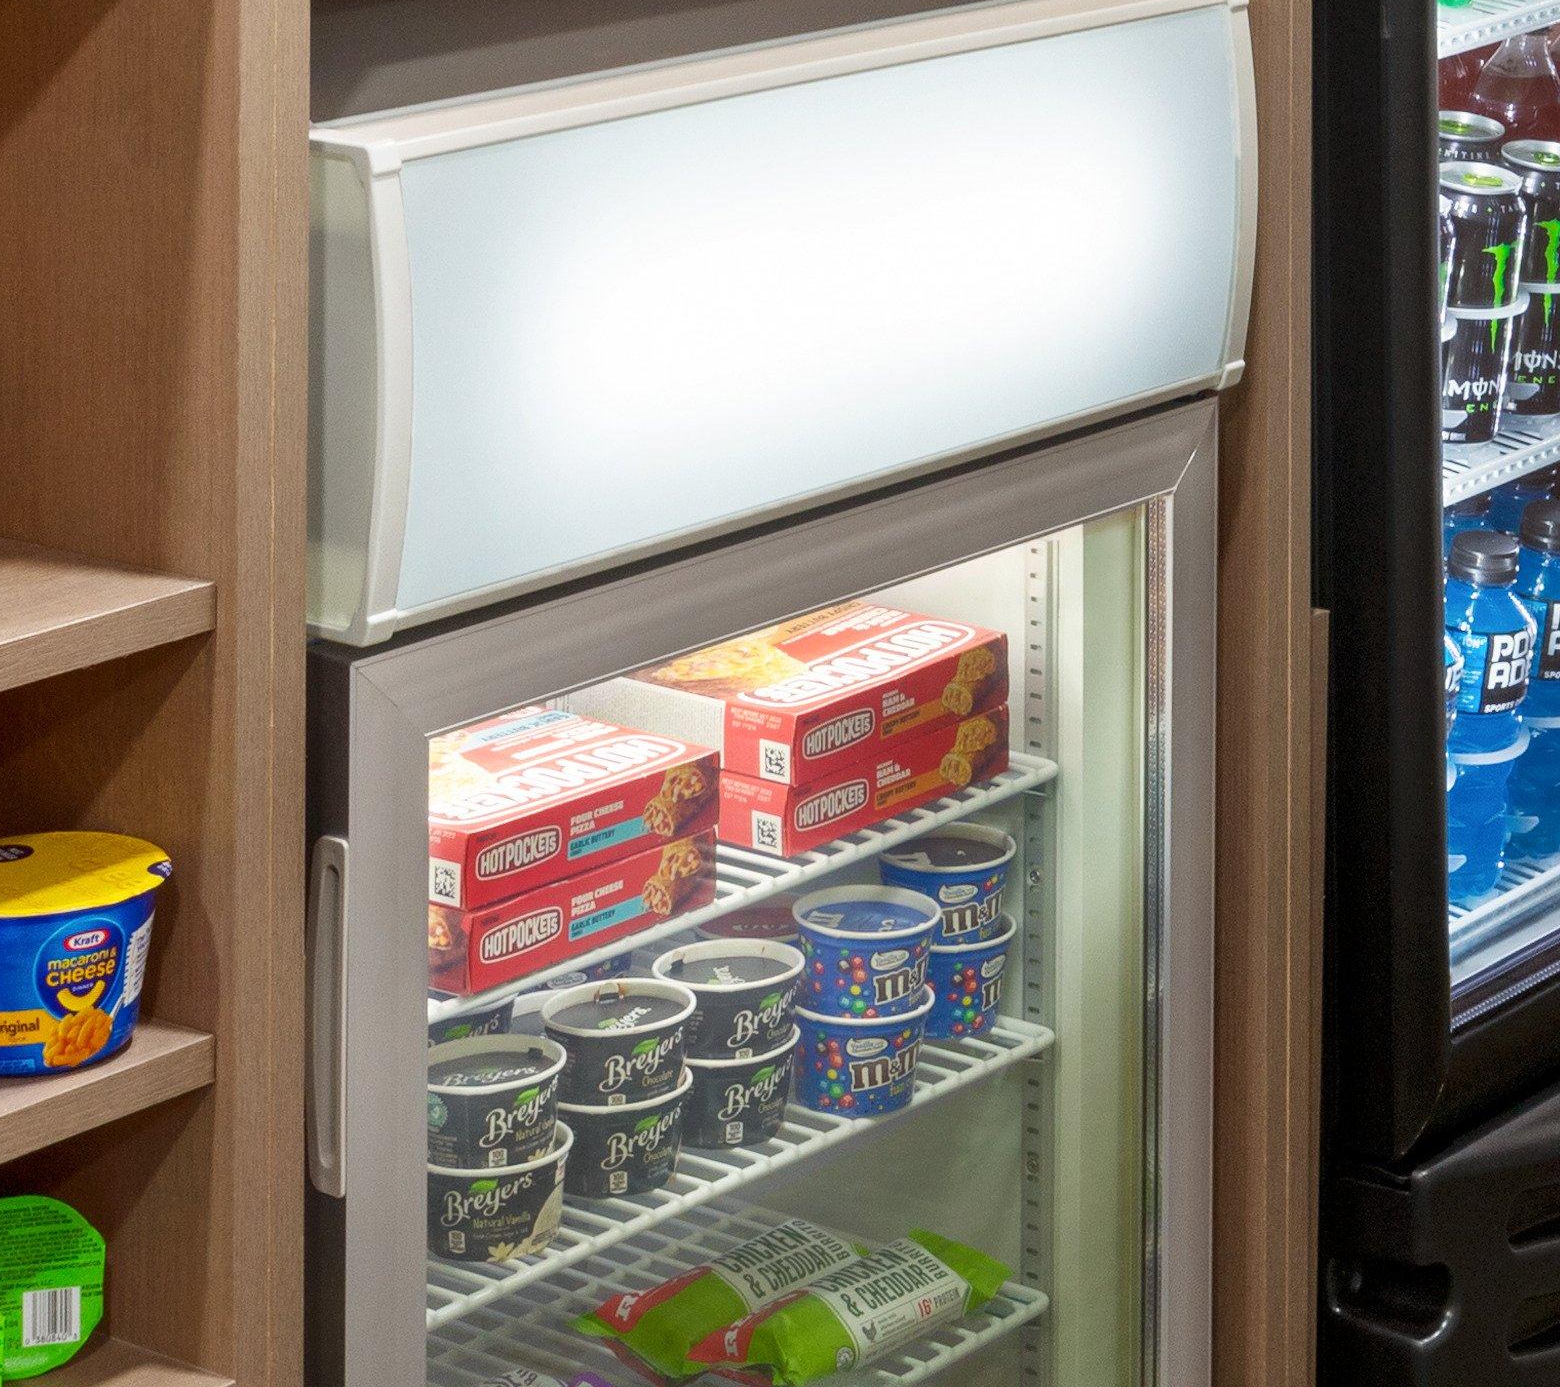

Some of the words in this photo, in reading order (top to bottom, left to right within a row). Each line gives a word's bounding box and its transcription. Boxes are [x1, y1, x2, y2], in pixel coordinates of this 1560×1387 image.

[48, 953, 108, 973] macaroni
[72, 932, 102, 948] Kraft
[599, 1027, 684, 1092] Breyers
[601, 1102, 682, 1171] Breyers
[441, 1171, 534, 1227] Breyers
[473, 1214, 507, 1230] Natural
[723, 1223, 814, 1273] CHICKEN
[765, 1244, 839, 1292] CHEDDAR
[841, 1292, 863, 1317] &
[863, 1264, 935, 1310] CHEDDAR
